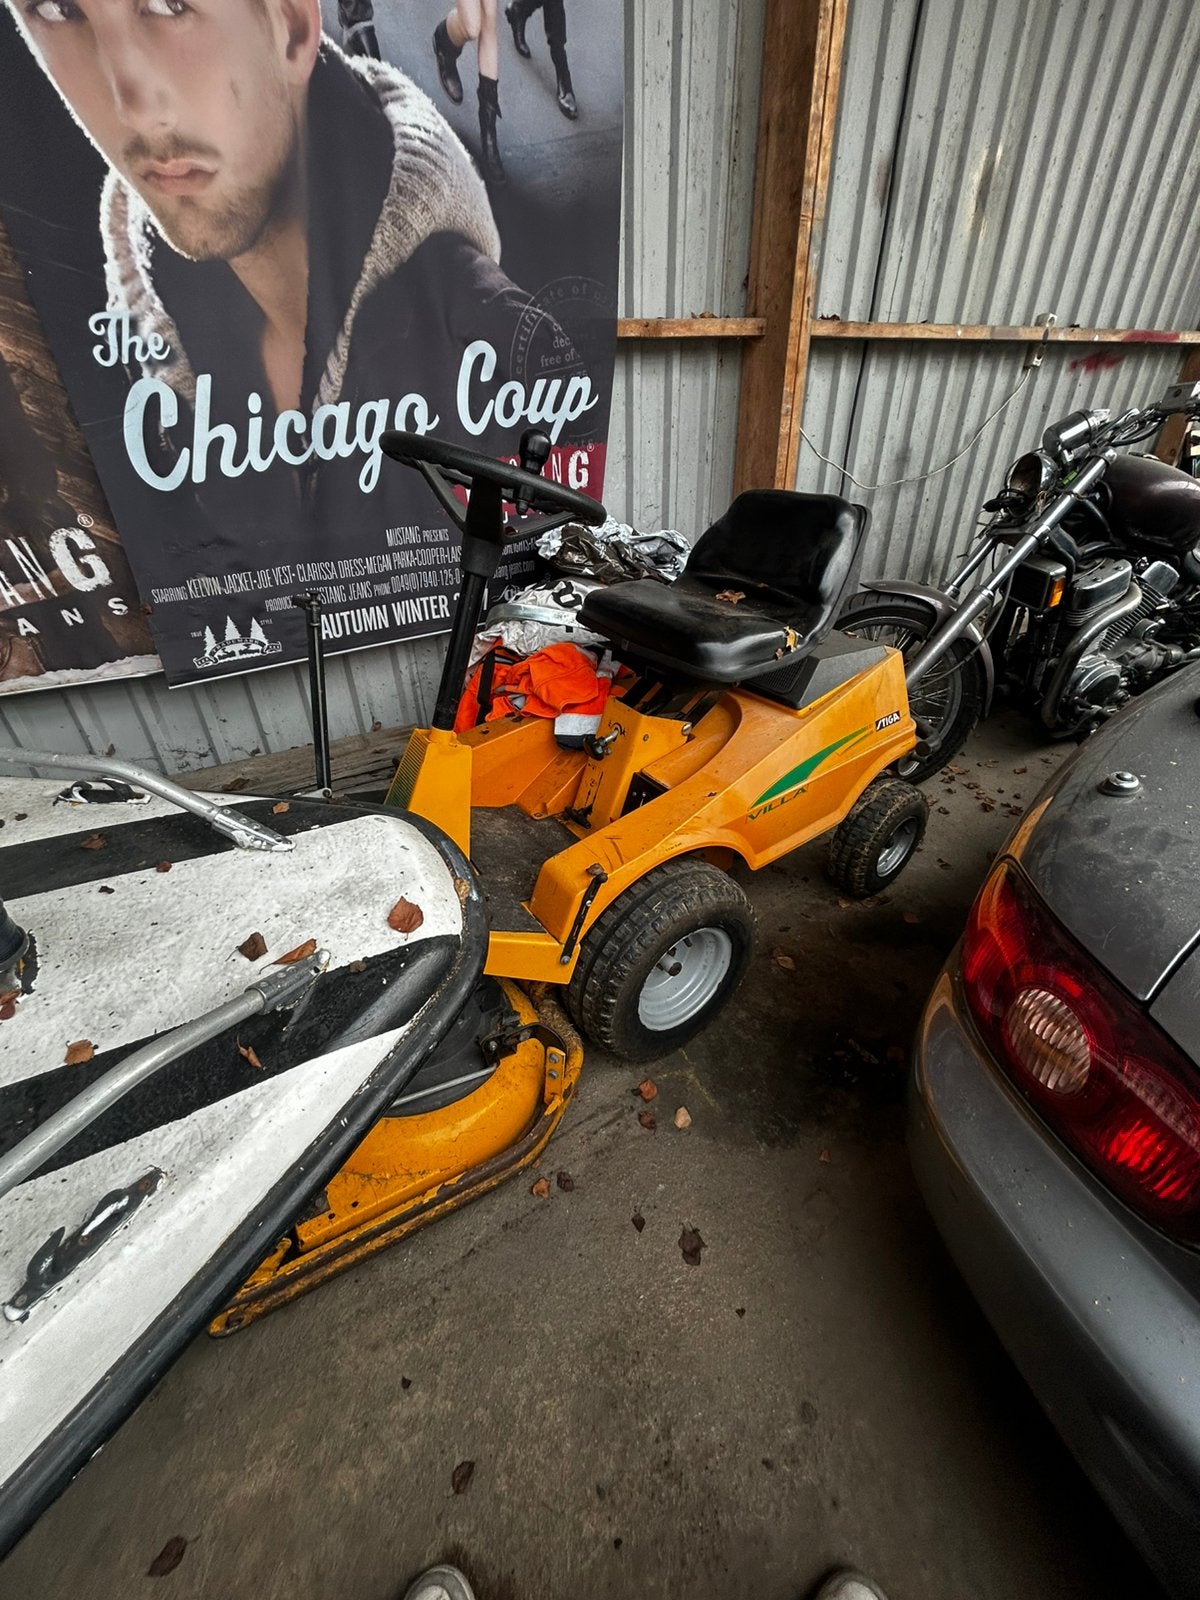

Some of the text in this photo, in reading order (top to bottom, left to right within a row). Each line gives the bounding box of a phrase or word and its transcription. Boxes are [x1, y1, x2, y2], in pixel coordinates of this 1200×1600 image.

[88, 309, 170, 367] The
[540, 355, 562, 368] free
[123, 374, 439, 494] Chicago
[457, 340, 599, 446] Coup
[386, 526, 450, 547] MUSTANG PRESENTS
[151, 585, 189, 604] STARRING
[186, 576, 222, 599] KELVIN
[296, 561, 338, 582] CLARISSA
[348, 580, 373, 601] JEANS
[373, 581, 392, 597] PHONE
[320, 604, 389, 640] AUTUMN
[391, 595, 451, 626] WINTER
[746, 785, 808, 821] VILLA
